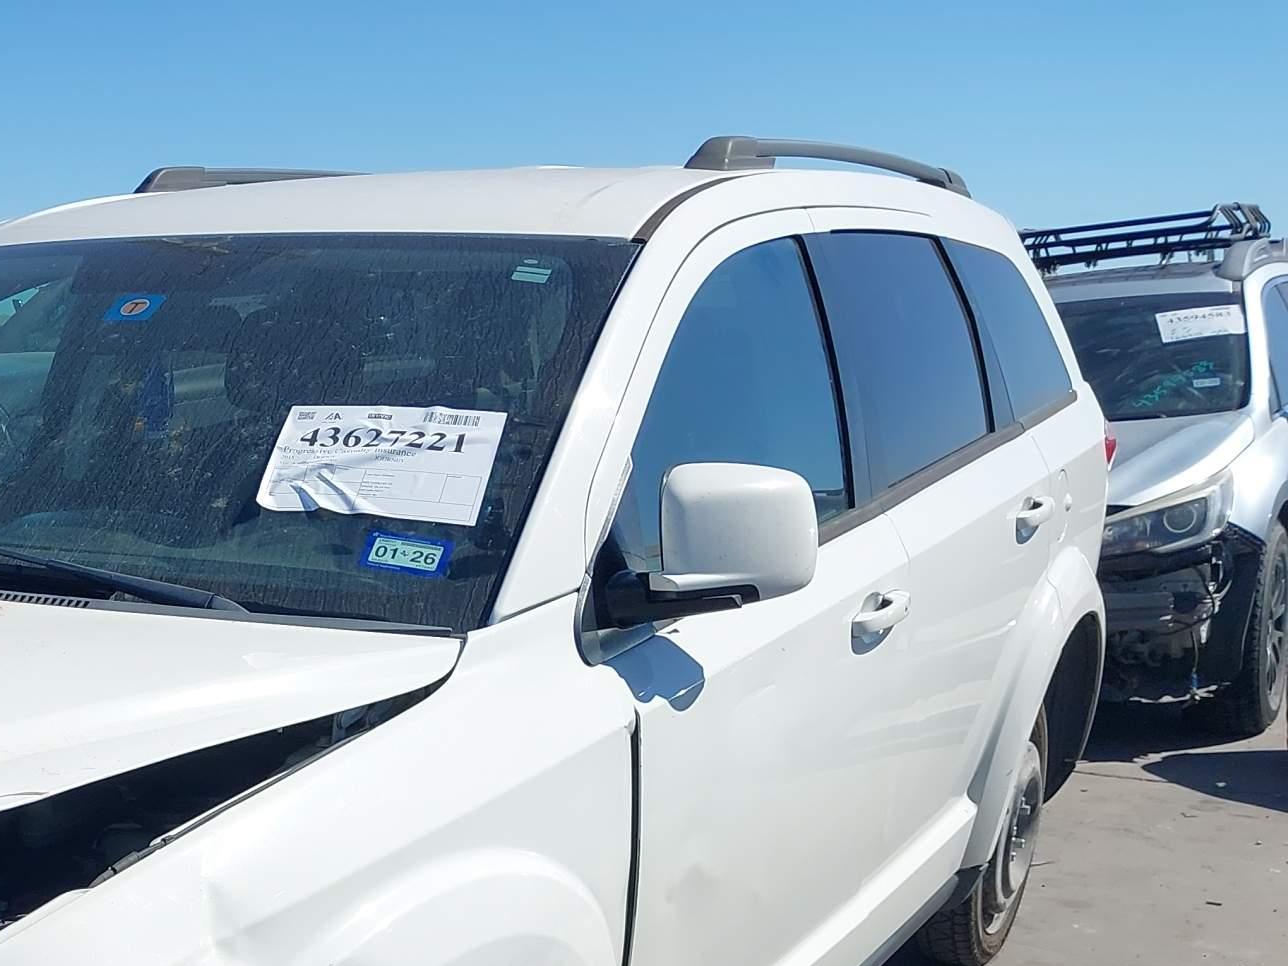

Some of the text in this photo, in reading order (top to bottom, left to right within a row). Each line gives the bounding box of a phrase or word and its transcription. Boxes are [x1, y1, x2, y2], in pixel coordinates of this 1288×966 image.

[300, 426, 466, 453] 43627221
[374, 545, 399, 560] 01
[409, 550, 437, 566] 26
